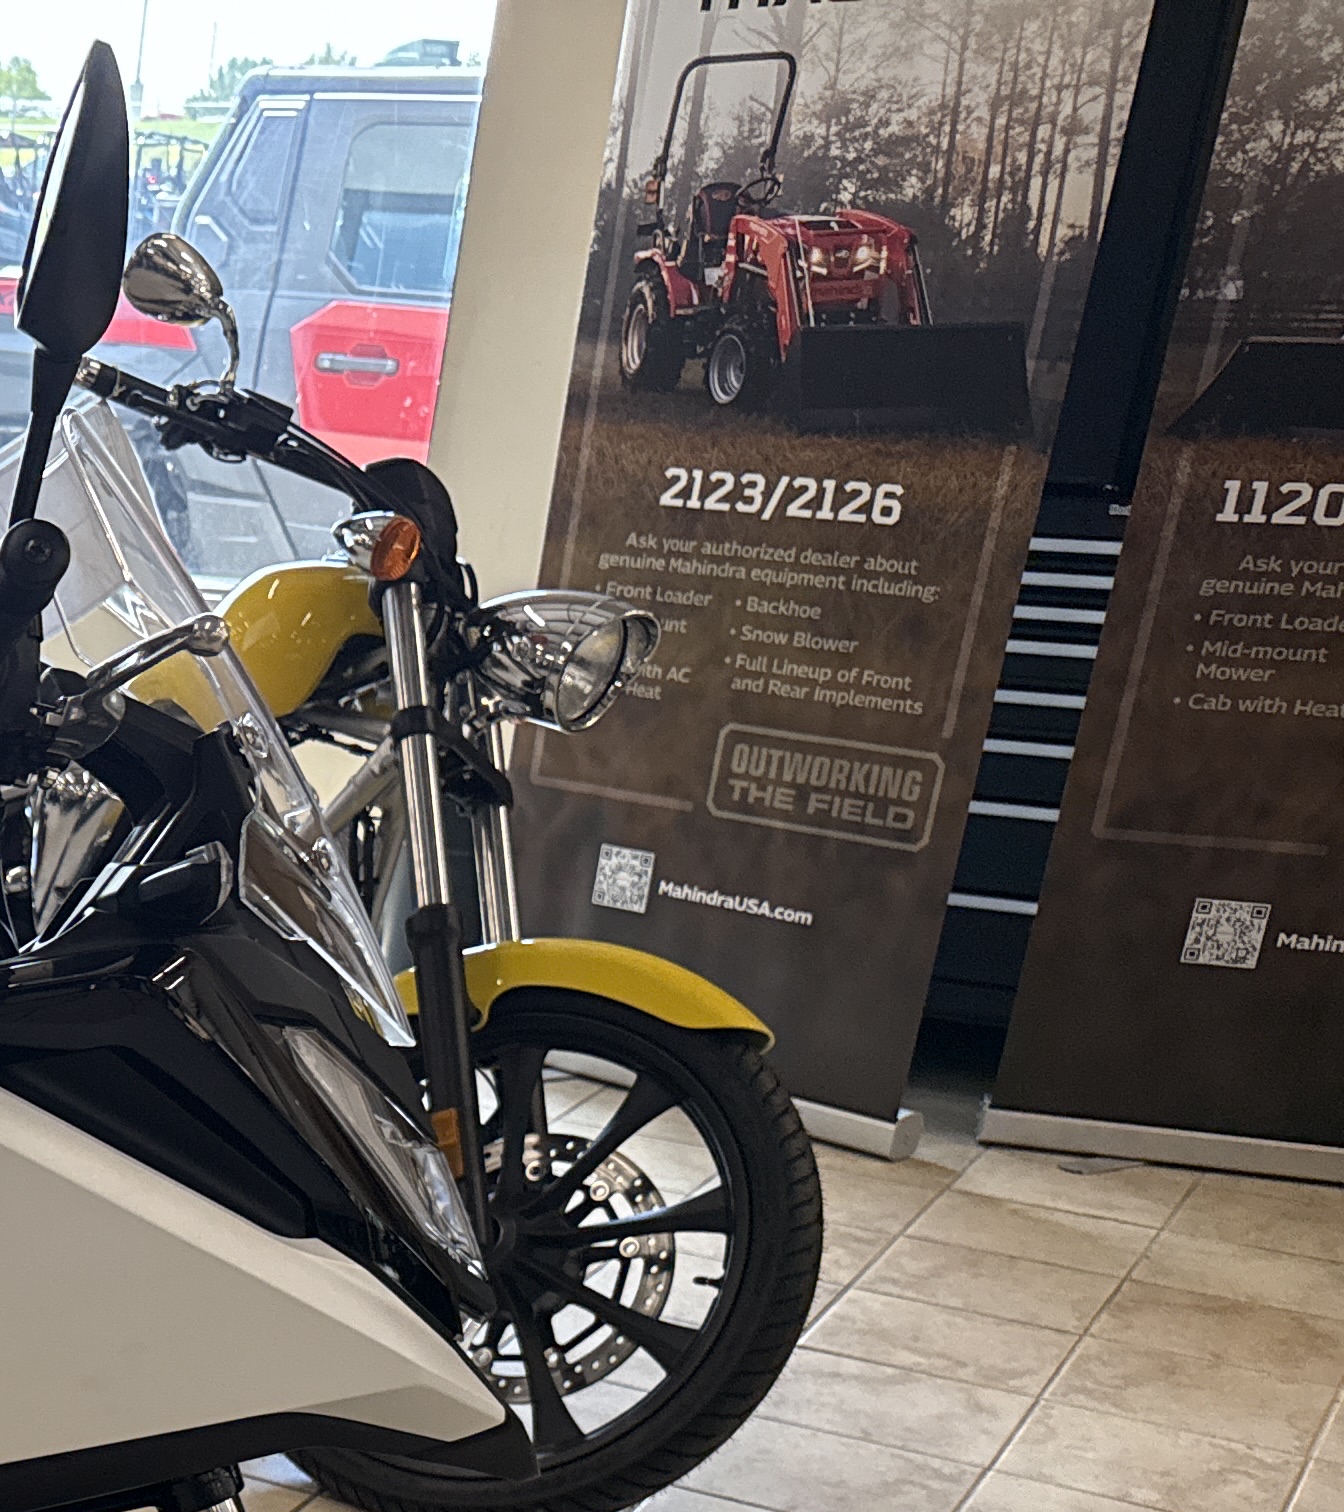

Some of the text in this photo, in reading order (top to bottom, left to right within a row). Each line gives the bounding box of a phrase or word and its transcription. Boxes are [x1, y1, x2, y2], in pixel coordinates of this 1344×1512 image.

[659, 467, 904, 526] 2123/2126
[625, 532, 919, 575] Ask your authorized dealer about
[1238, 554, 1283, 573] Ask
[598, 552, 941, 603] genuine Mahindra equipment including:
[1199, 578, 1295, 597] genuine
[606, 581, 713, 607] Front Loader
[746, 596, 822, 620] Backhoe
[1209, 609, 1274, 628] Front
[740, 624, 858, 653] Snow Blower
[1201, 640, 1328, 663] Mid-mount
[666, 666, 691, 684] AC
[735, 653, 912, 692] Full Lineup of Front
[1196, 662, 1275, 682] Mower
[731, 676, 924, 715] and Rear Implements
[1188, 693, 1232, 711] Cab
[1238, 696, 1287, 715] with
[731, 743, 923, 802] OUTWORKING
[727, 779, 915, 831] THE FIELD
[658, 880, 813, 926] MahindraUSA.com
